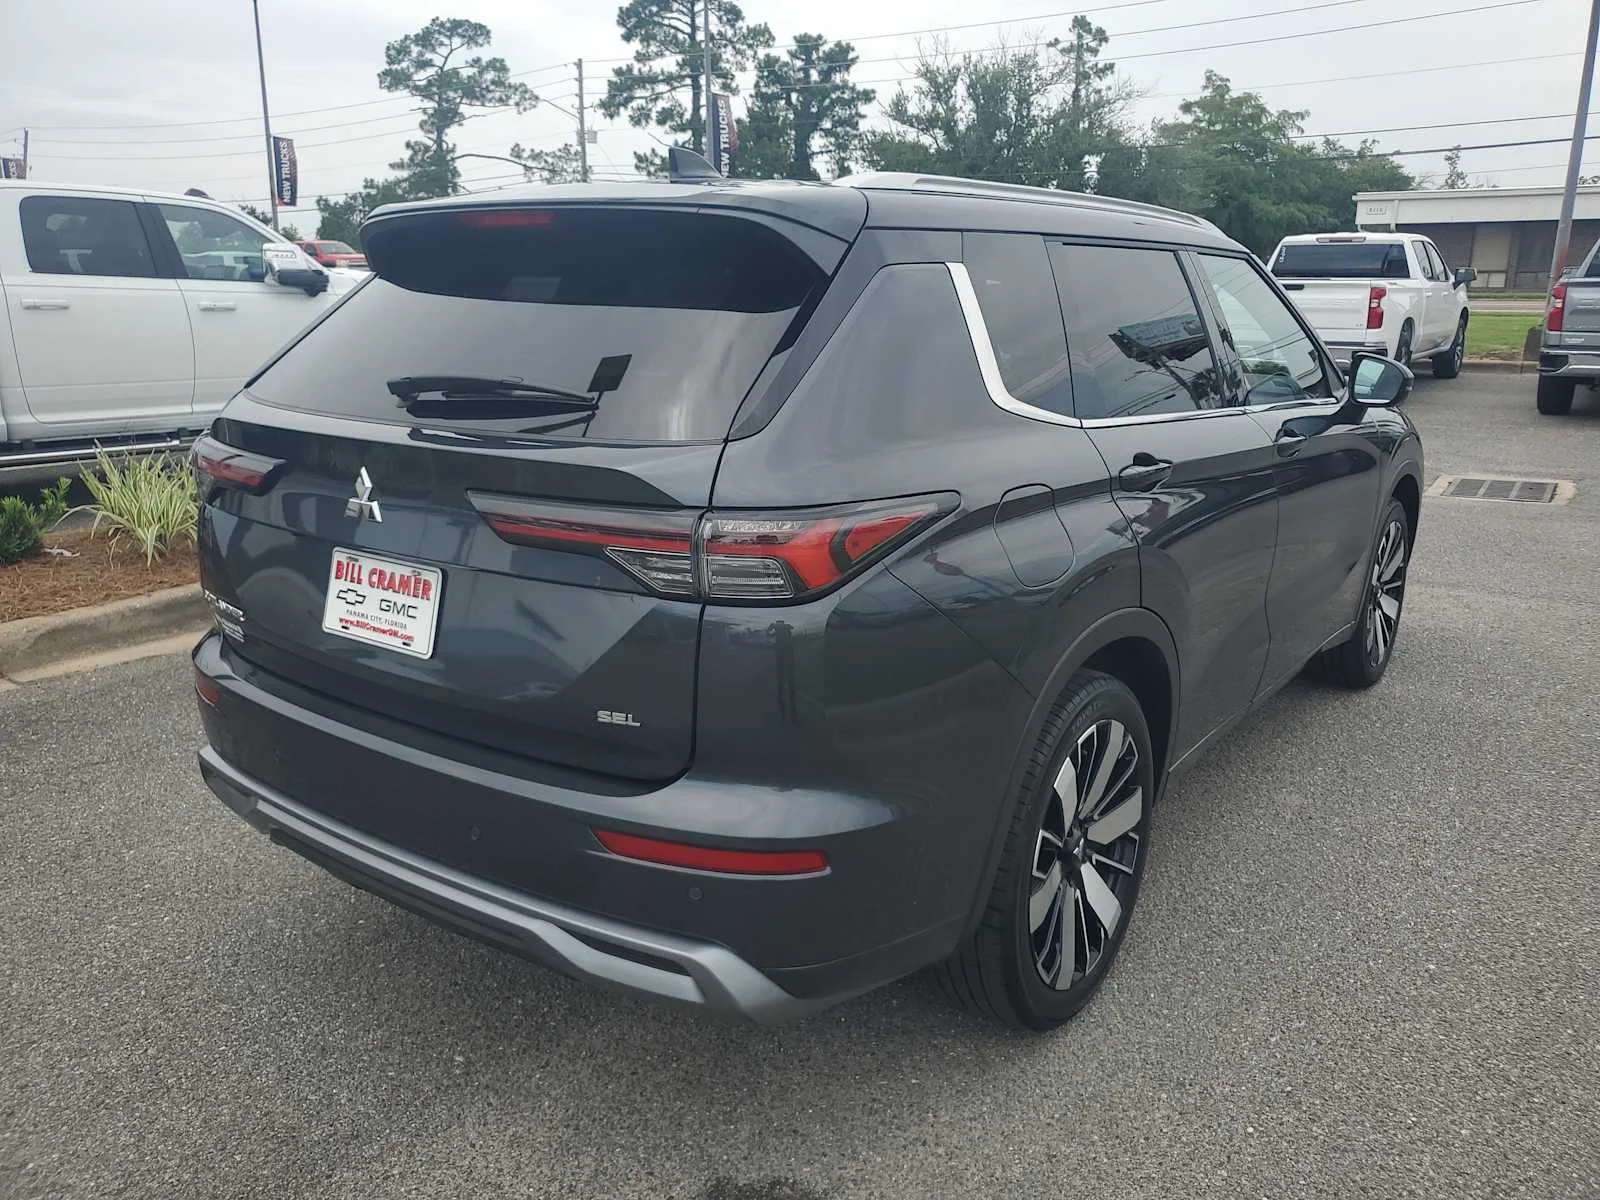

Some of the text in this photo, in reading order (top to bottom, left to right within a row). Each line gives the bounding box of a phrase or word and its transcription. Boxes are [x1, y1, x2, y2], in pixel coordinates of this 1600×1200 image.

[717, 99, 730, 150] TRUCKS
[280, 142, 291, 203] NEW TRUCKS
[335, 560, 432, 601] BILL CRAMER
[346, 609, 407, 629] PANAMA CITY, FLORIDA
[380, 599, 418, 619] GMC
[597, 710, 640, 726] SEL
